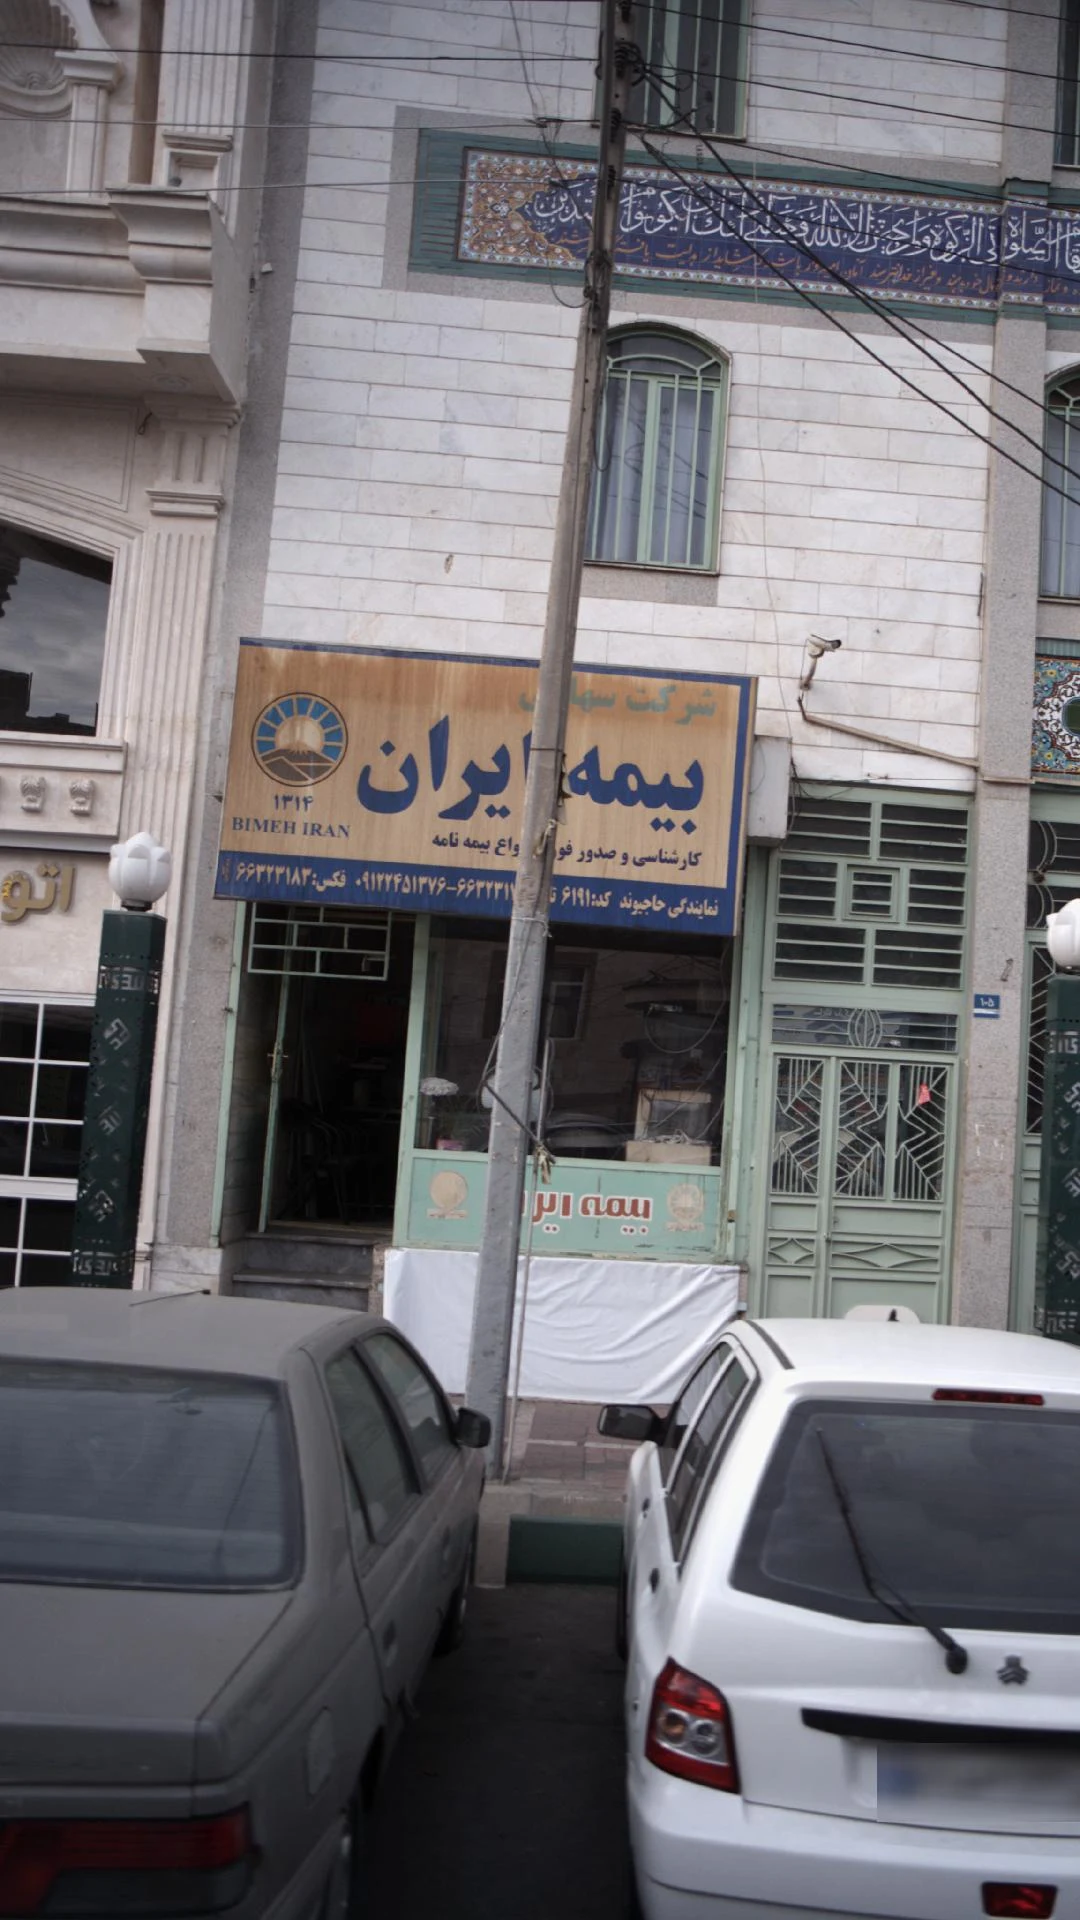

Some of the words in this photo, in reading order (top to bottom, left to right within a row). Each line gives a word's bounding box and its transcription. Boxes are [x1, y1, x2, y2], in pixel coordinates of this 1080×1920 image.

[626, 685, 717, 725] شرکت
[568, 745, 704, 835] بیمه
[274, 793, 314, 812] ۱۳۱۴
[231, 816, 297, 835] BIMEH
[302, 822, 350, 839] IRAN
[432, 832, 459, 848] نامه
[463, 838, 491, 855] بیمه
[576, 847, 616, 863] صدور
[621, 851, 629, 866] و
[632, 848, 702, 871] کارشناسی
[667, 898, 719, 919] نمایندگی
[521, 1191, 573, 1233] ایر
[579, 1194, 652, 1234] بیمه
